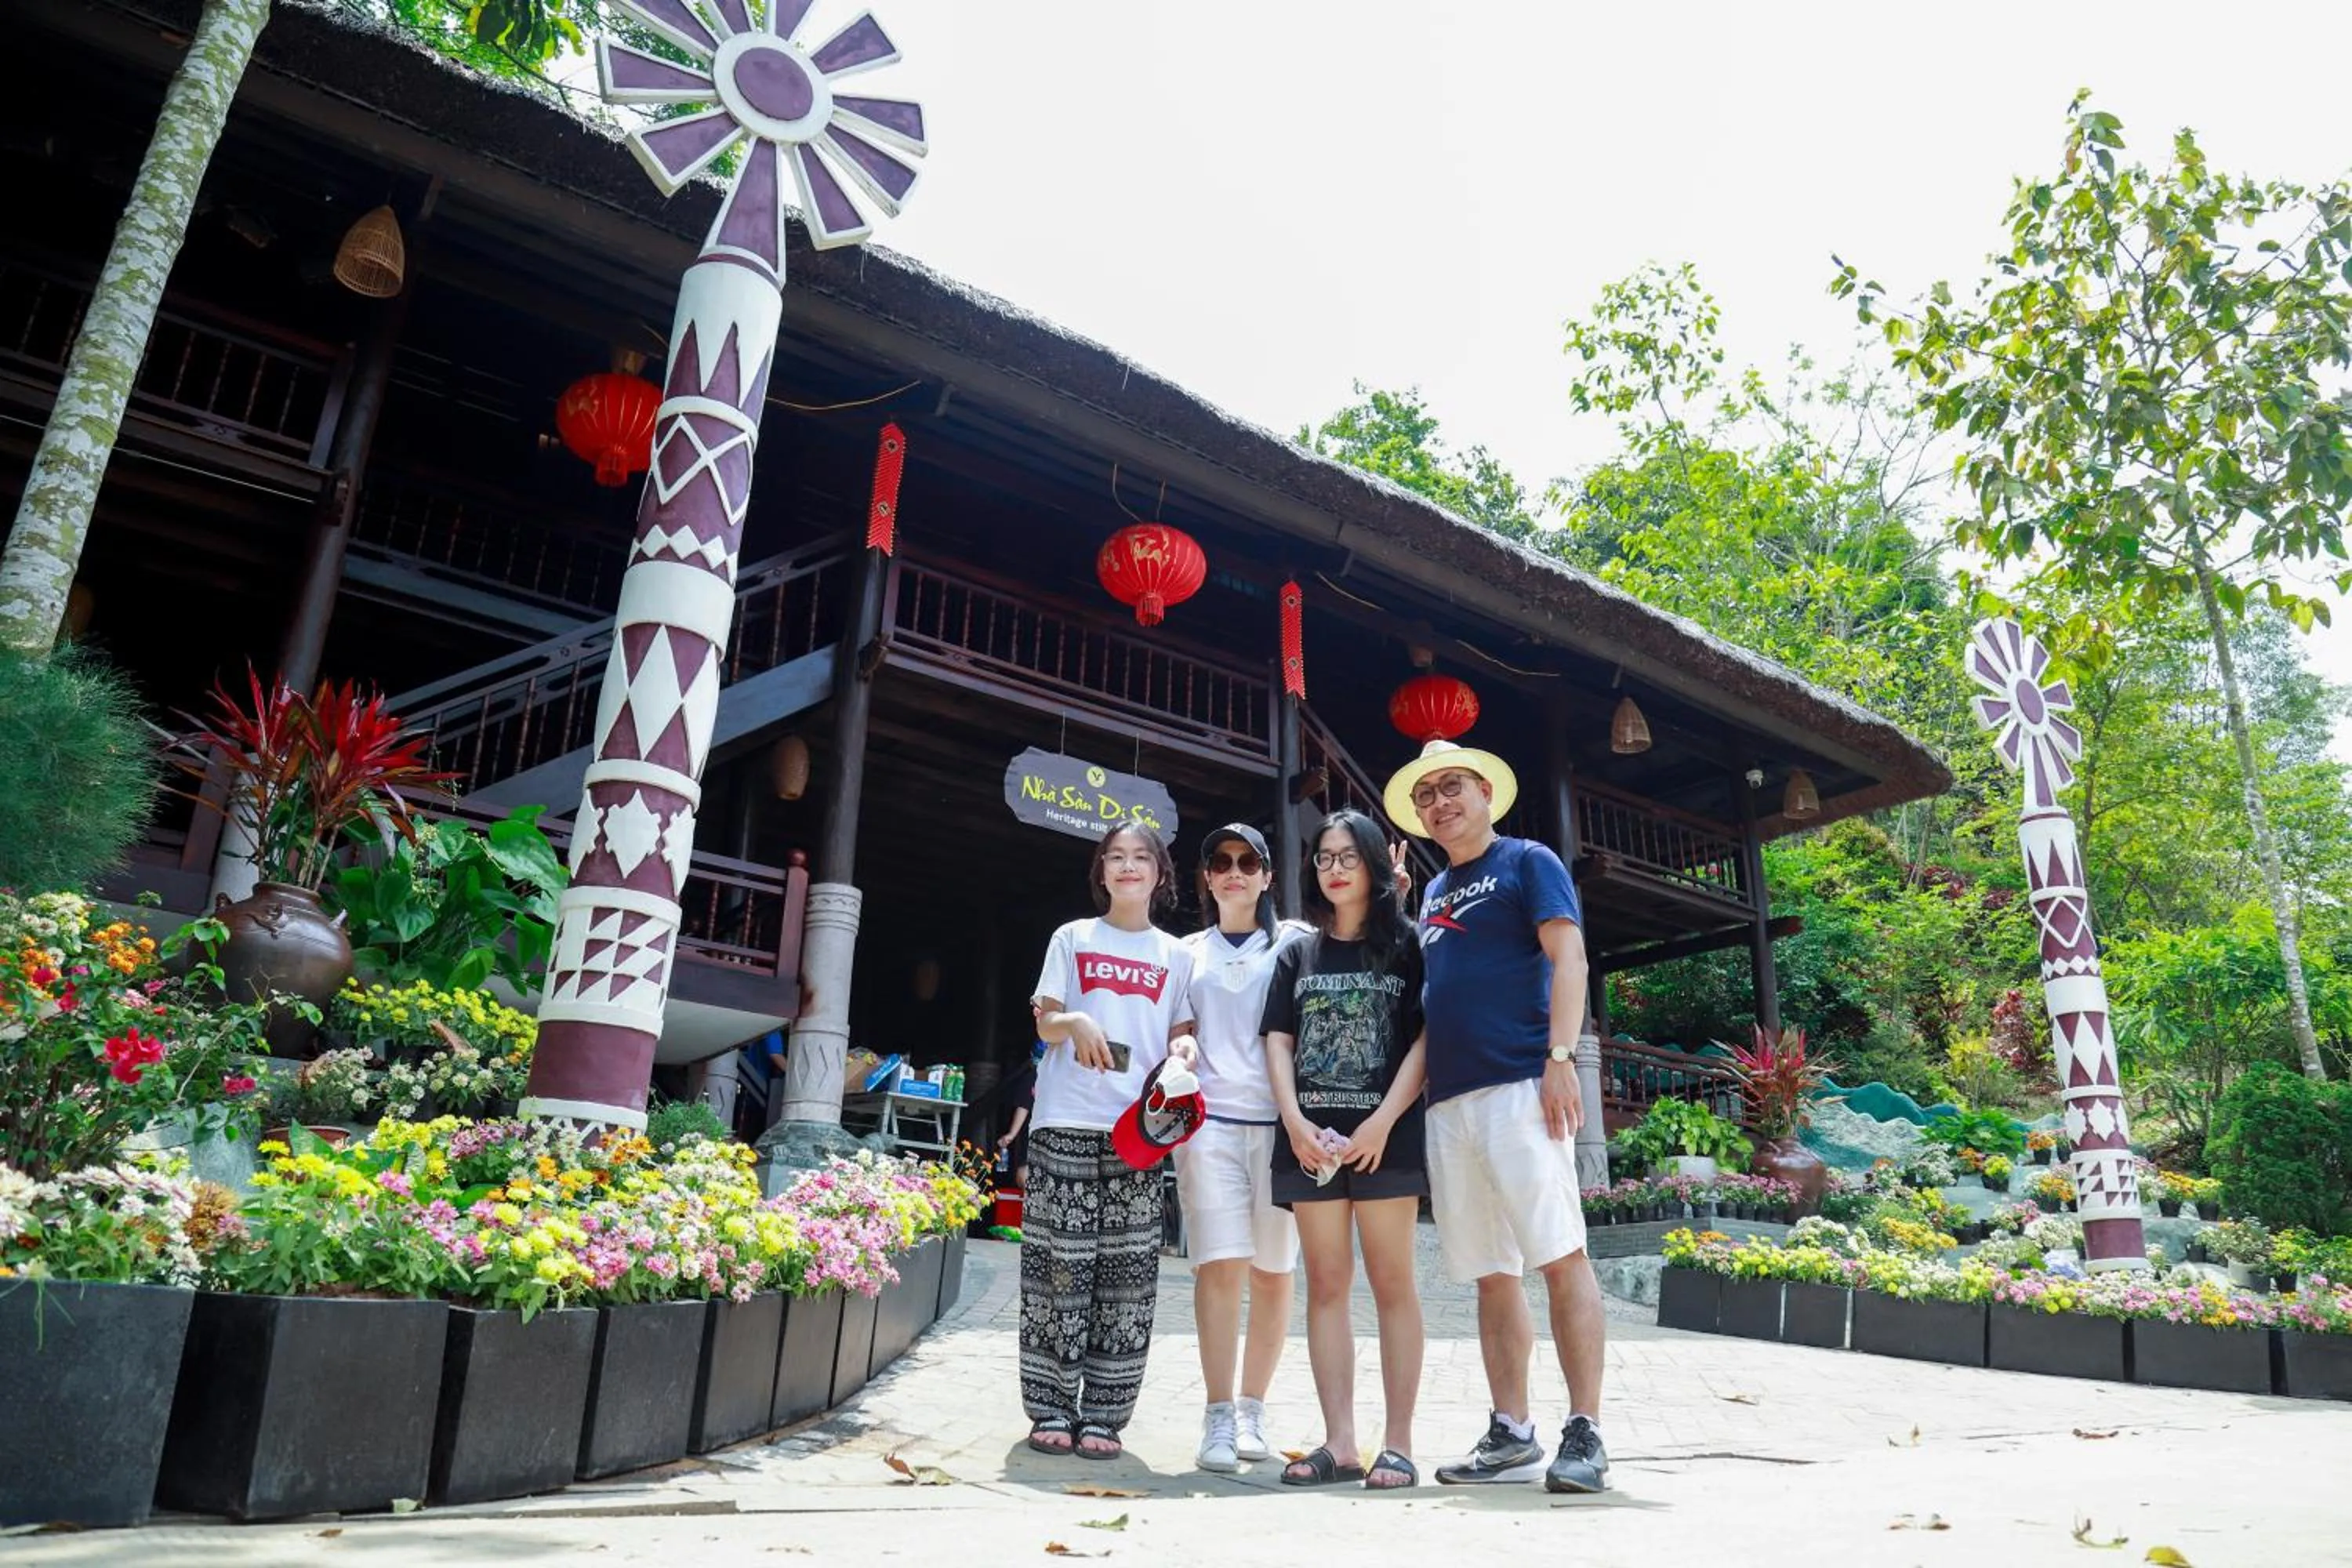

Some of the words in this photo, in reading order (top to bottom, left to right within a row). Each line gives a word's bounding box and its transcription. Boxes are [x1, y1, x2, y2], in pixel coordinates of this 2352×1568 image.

[1022, 775, 1057, 803] Nhà
[1059, 786, 1093, 811] Sàn
[1098, 793, 1127, 820] Di
[1046, 808, 1087, 828] Heritage
